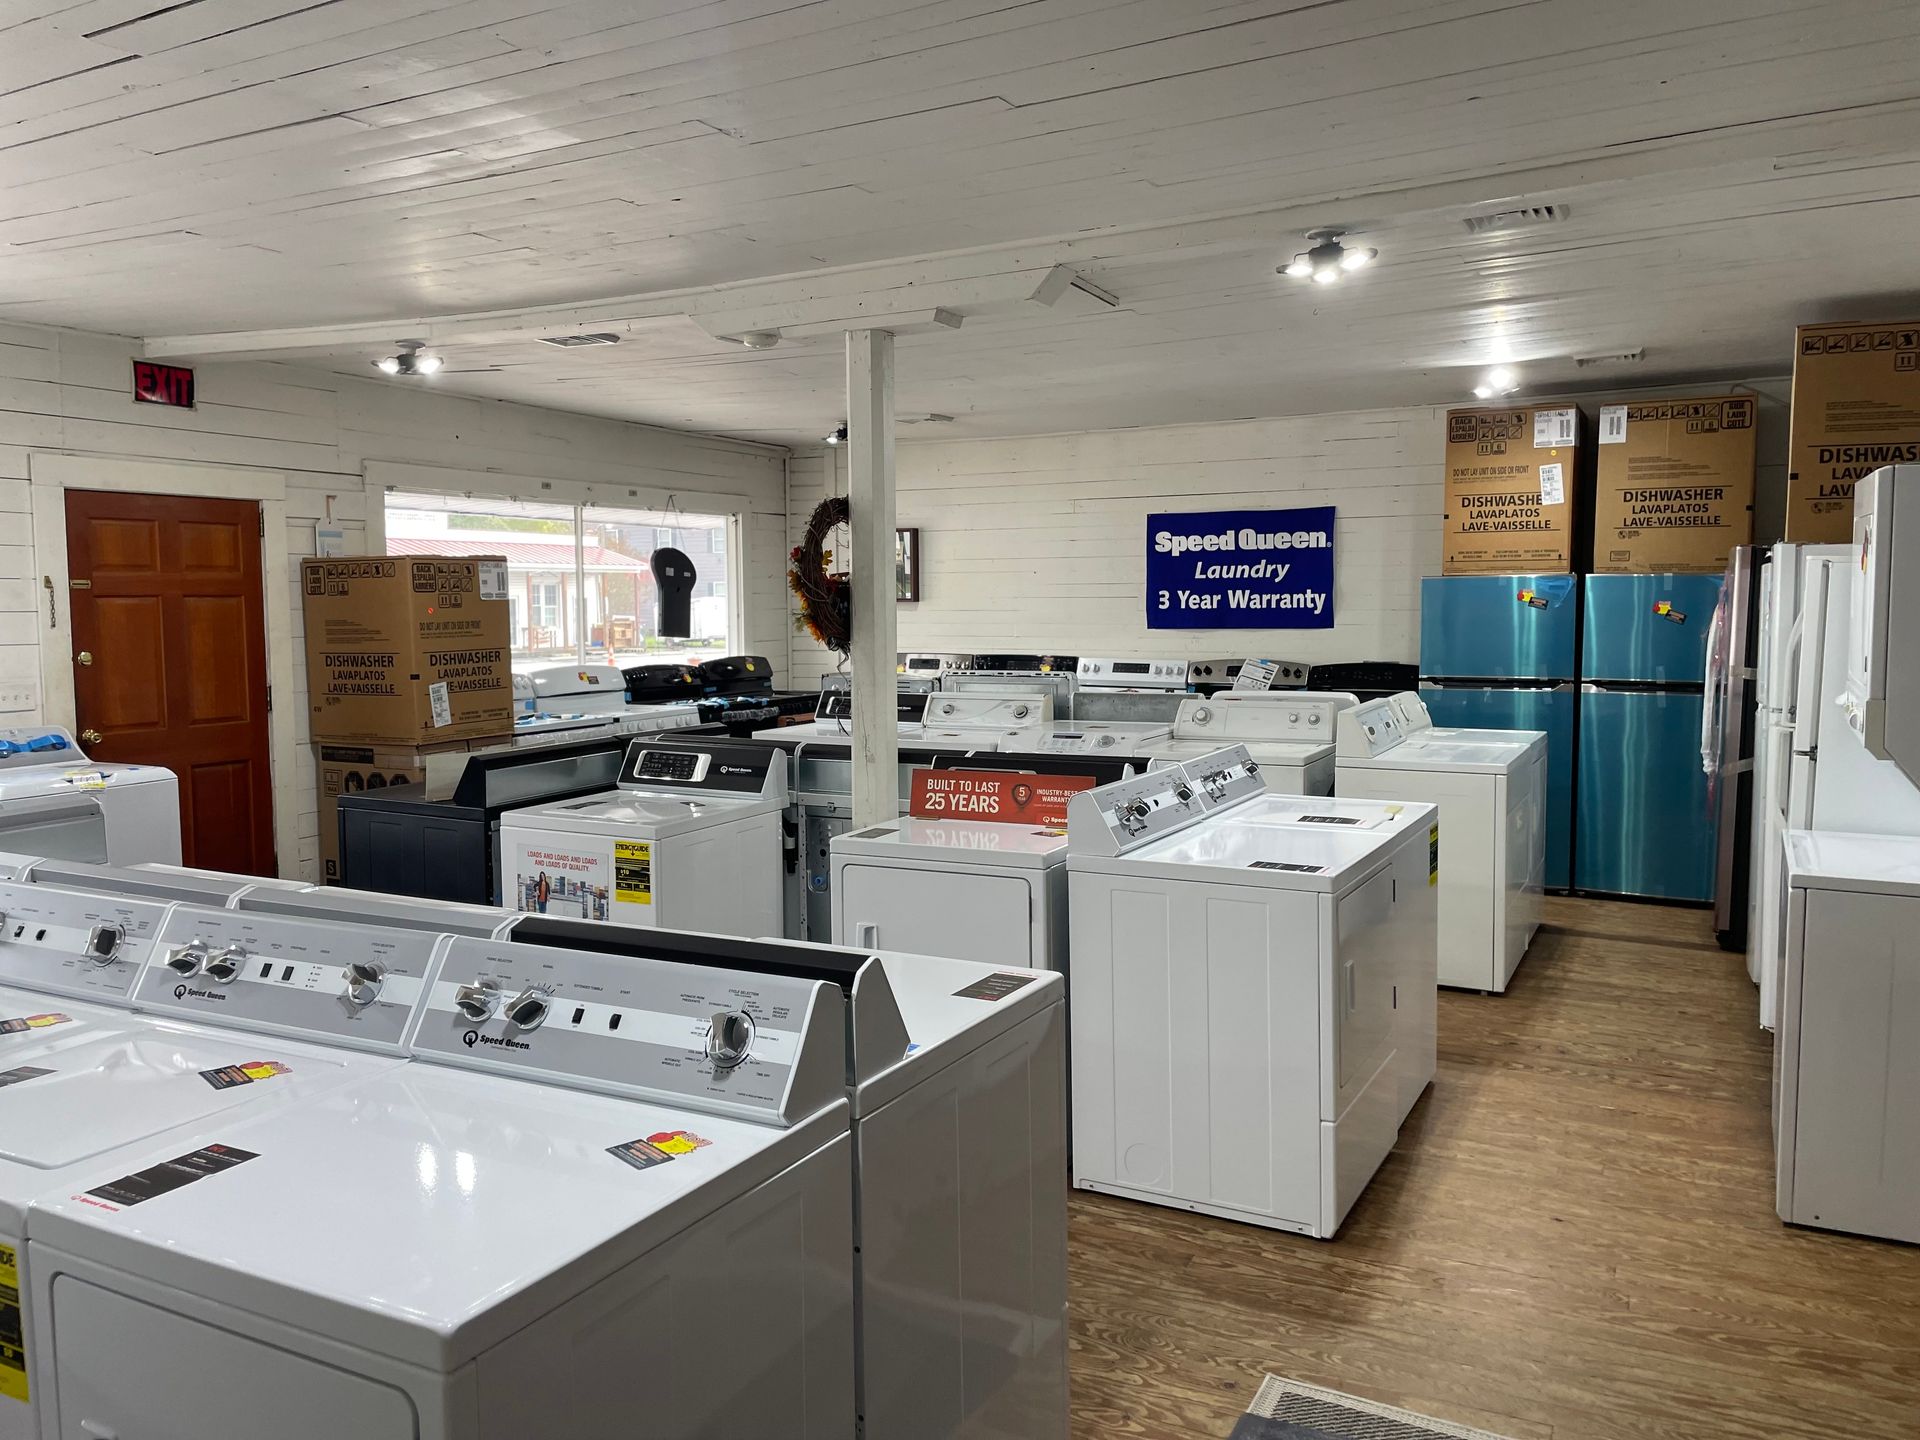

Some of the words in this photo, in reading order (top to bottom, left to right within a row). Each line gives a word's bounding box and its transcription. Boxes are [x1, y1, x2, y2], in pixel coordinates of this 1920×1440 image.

[136, 364, 192, 405] EXIT
[1819, 446, 1920, 463] DISHWAS
[1490, 467, 1497, 475] ON
[1515, 465, 1529, 473] FRONT
[1462, 495, 1542, 507] DISHWASHE
[1623, 489, 1723, 502] DISHWASHER
[1470, 508, 1540, 519] LAVAPLATOS
[1632, 503, 1709, 514] LAVAPLATOS
[1462, 520, 1551, 531] LAVE-VAISSELLE
[1623, 516, 1721, 527] LAVE-VAISSELLE
[1155, 530, 1235, 556] Speed
[1195, 559, 1290, 582] Laundry
[1159, 591, 1170, 609] 3
[1177, 590, 1221, 609] Year
[1228, 589, 1326, 614] Warranty
[325, 655, 394, 667] DISHWASHER
[430, 651, 501, 666] DISHWASHER
[333, 670, 385, 680] LAVAPLATOS
[438, 667, 493, 679] LAVAPLATOS
[328, 683, 394, 694] LAVE-VAISSELLE
[447, 678, 501, 691] E-VAISSELLE
[927, 779, 956, 792] BUILT
[959, 780, 972, 792] TO
[975, 781, 1000, 794] LAST
[1019, 788, 1025, 797] 5
[925, 792, 945, 810] 25
[949, 794, 1000, 814] YEARS
[527, 851, 542, 859] LOADS
[543, 852, 553, 860] AND
[554, 854, 569, 862] LOADS
[571, 855, 581, 863] AND
[582, 857, 597, 865] LOADS
[187, 988, 206, 997] Speed
[207, 991, 226, 1000] Queen
[480, 1035, 504, 1046] Speed
[506, 1038, 530, 1050] Queen
